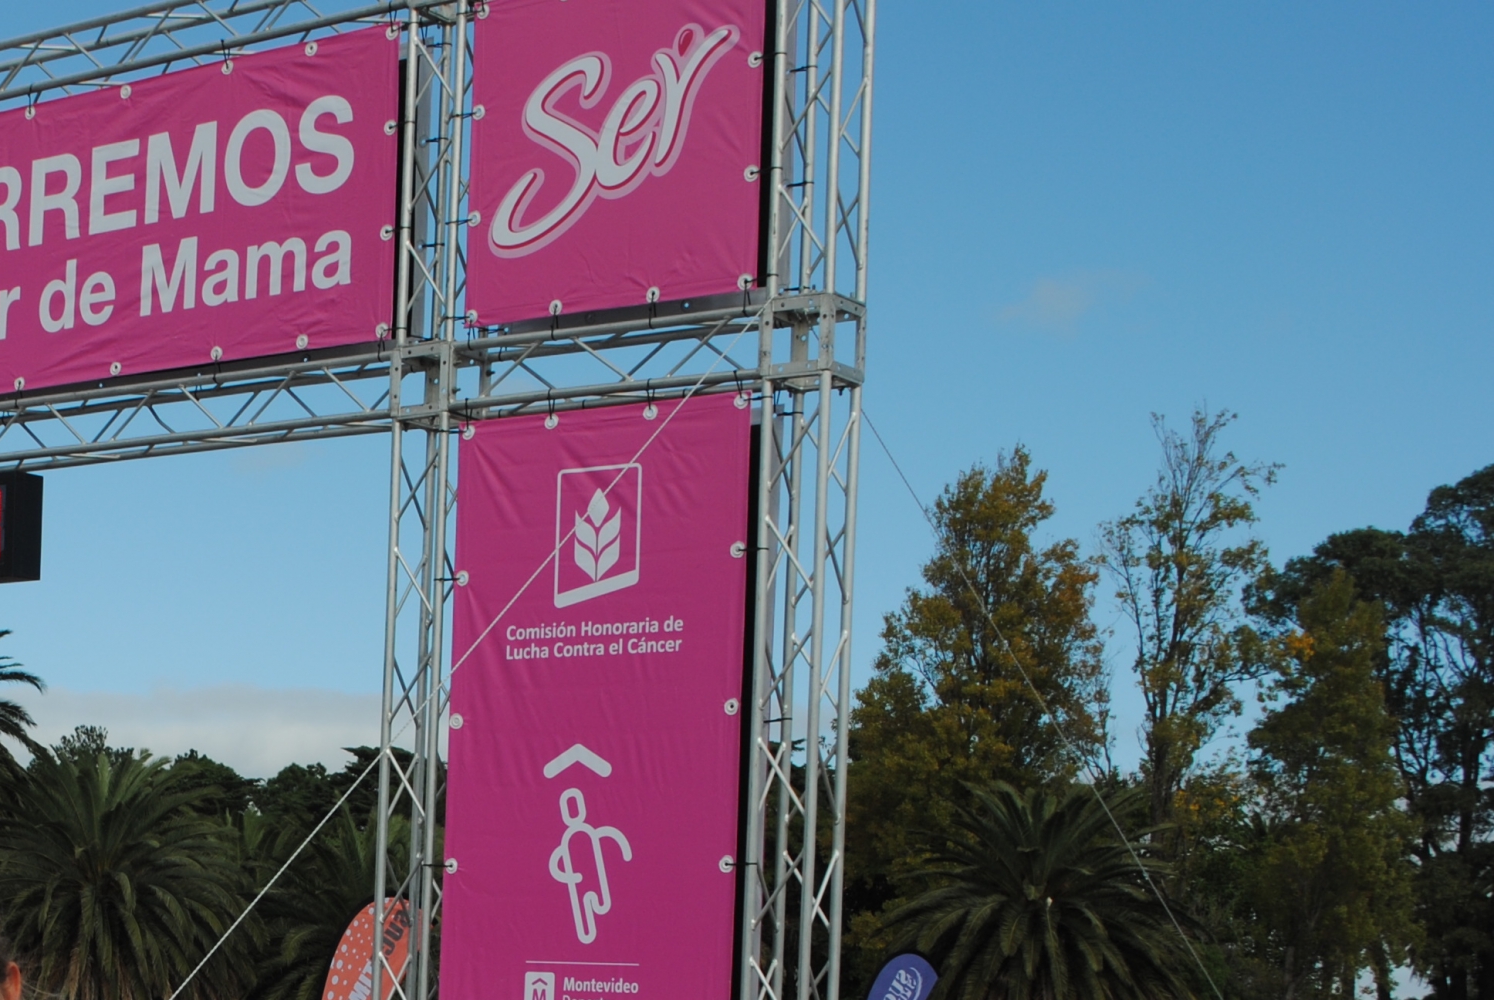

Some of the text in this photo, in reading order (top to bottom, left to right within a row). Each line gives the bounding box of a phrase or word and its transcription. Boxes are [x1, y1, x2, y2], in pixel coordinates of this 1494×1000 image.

[489, 24, 739, 257] Ser
[38, 259, 116, 333] de
[139, 229, 352, 317] Mama
[506, 615, 684, 641] Comisión Honoraria de
[506, 637, 682, 660] Lucha Contra el Cáncer
[563, 977, 639, 994] Montevideo
